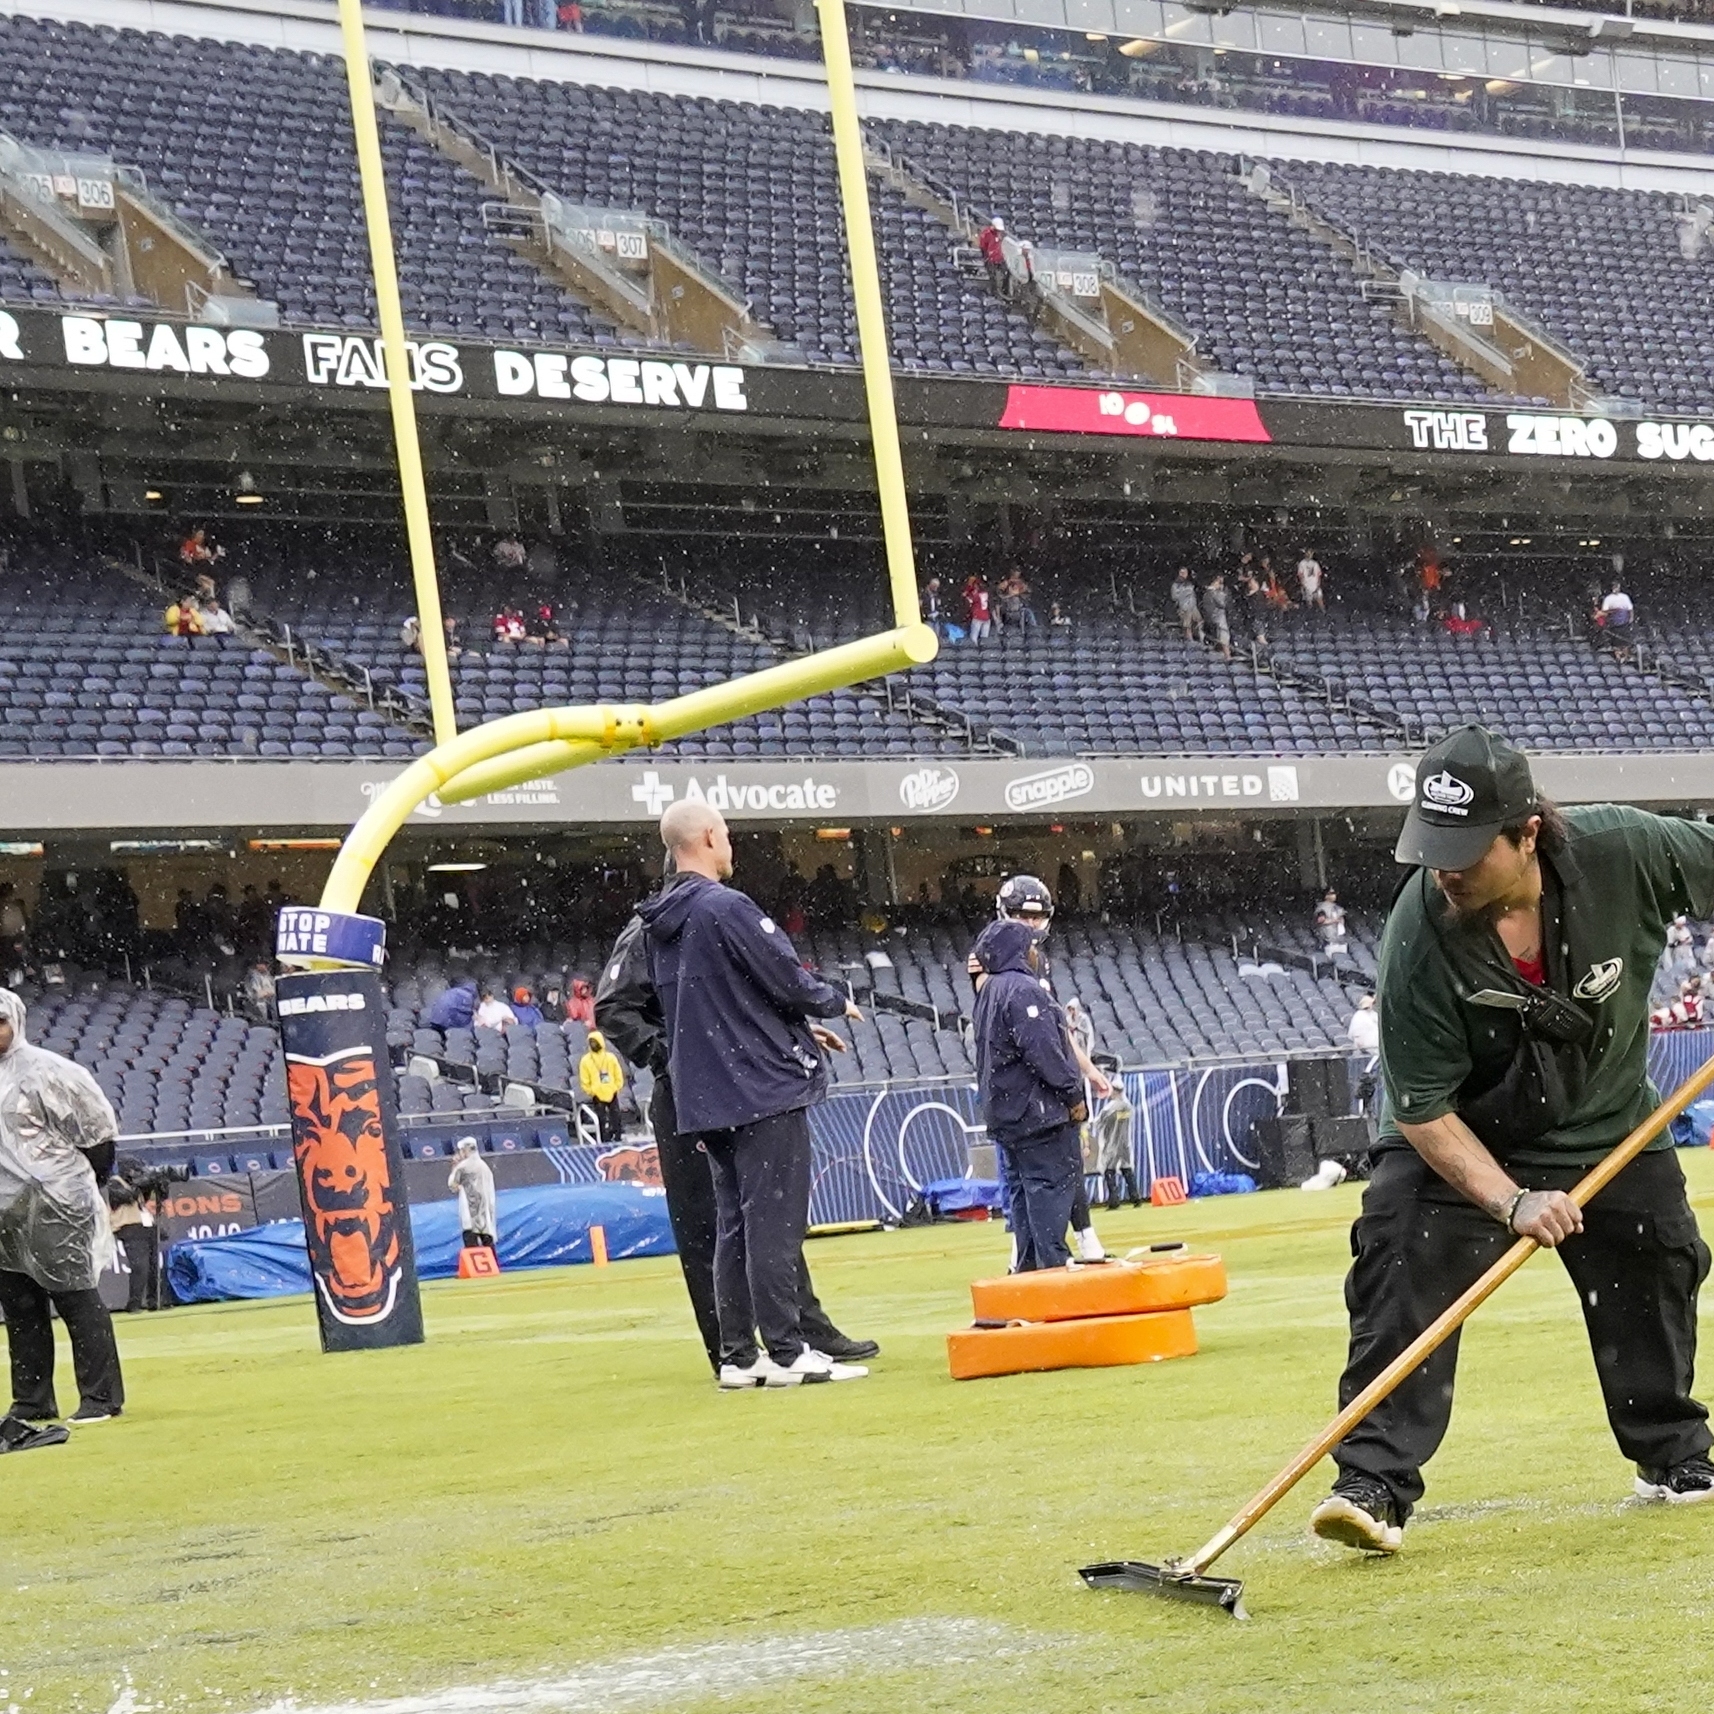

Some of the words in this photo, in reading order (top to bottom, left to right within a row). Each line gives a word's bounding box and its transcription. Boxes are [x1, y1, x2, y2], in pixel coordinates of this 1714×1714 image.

[81, 182, 110, 205] 306
[620, 234, 643, 255] 307
[62, 316, 270, 378] BEARS
[494, 350, 748, 411] DESERVE
[1404, 410, 1489, 451] THE
[1506, 414, 1618, 459] ZERO
[919, 768, 941, 788] Dr
[1011, 767, 1088, 804] snapple
[1141, 775, 1263, 798] UNITED
[684, 774, 837, 812] Advocate
[278, 912, 331, 933] STOP
[278, 993, 366, 1017] BEARS
[1158, 1181, 1182, 1202] 10
[469, 1251, 492, 1274] G
